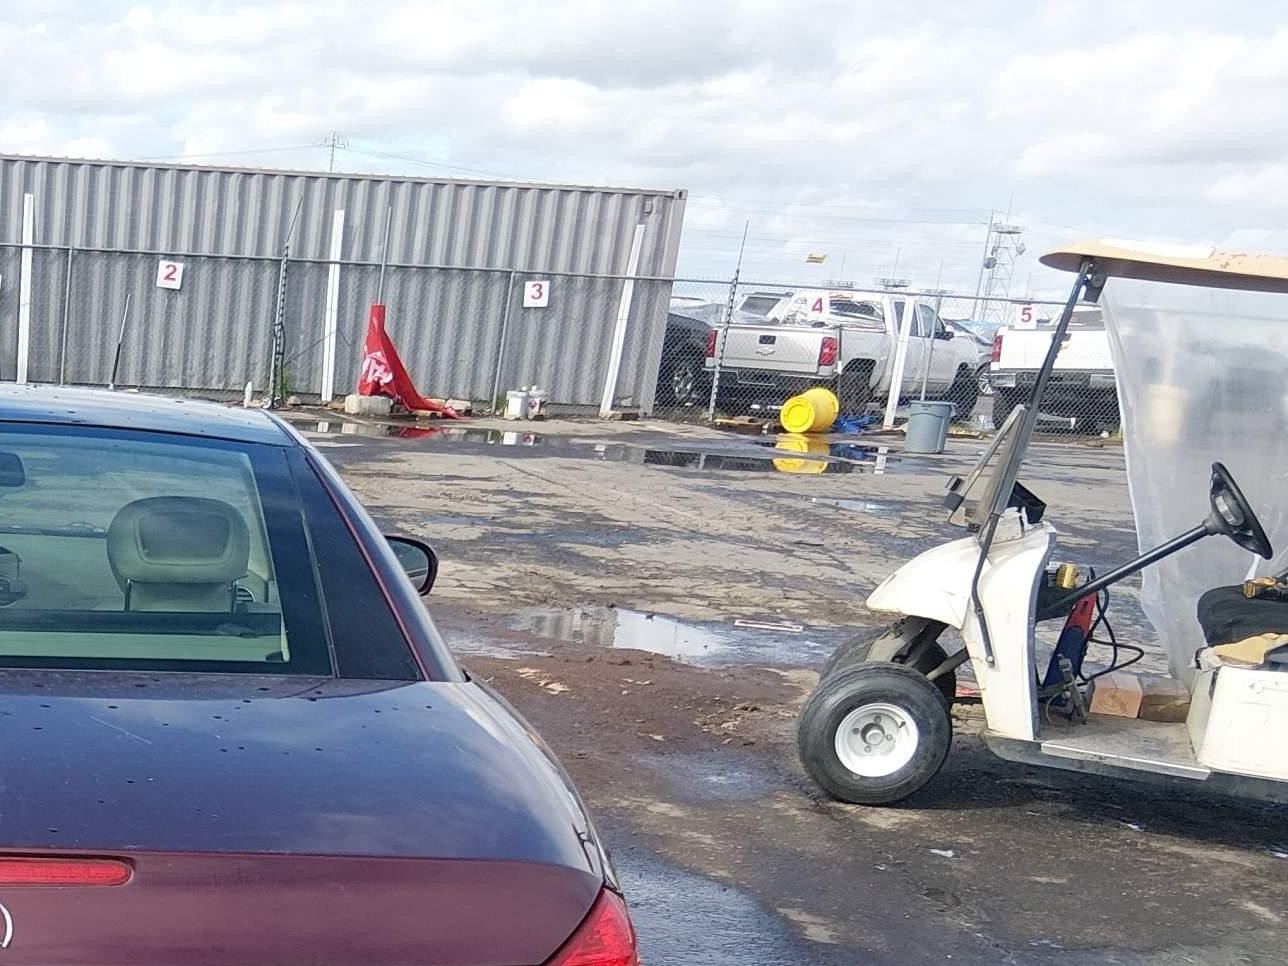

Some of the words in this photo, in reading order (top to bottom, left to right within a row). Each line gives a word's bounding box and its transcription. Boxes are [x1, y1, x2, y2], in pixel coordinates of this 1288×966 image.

[163, 264, 177, 281] 2
[531, 283, 543, 300] 3
[811, 297, 823, 314] 4
[1021, 307, 1032, 323] 5
